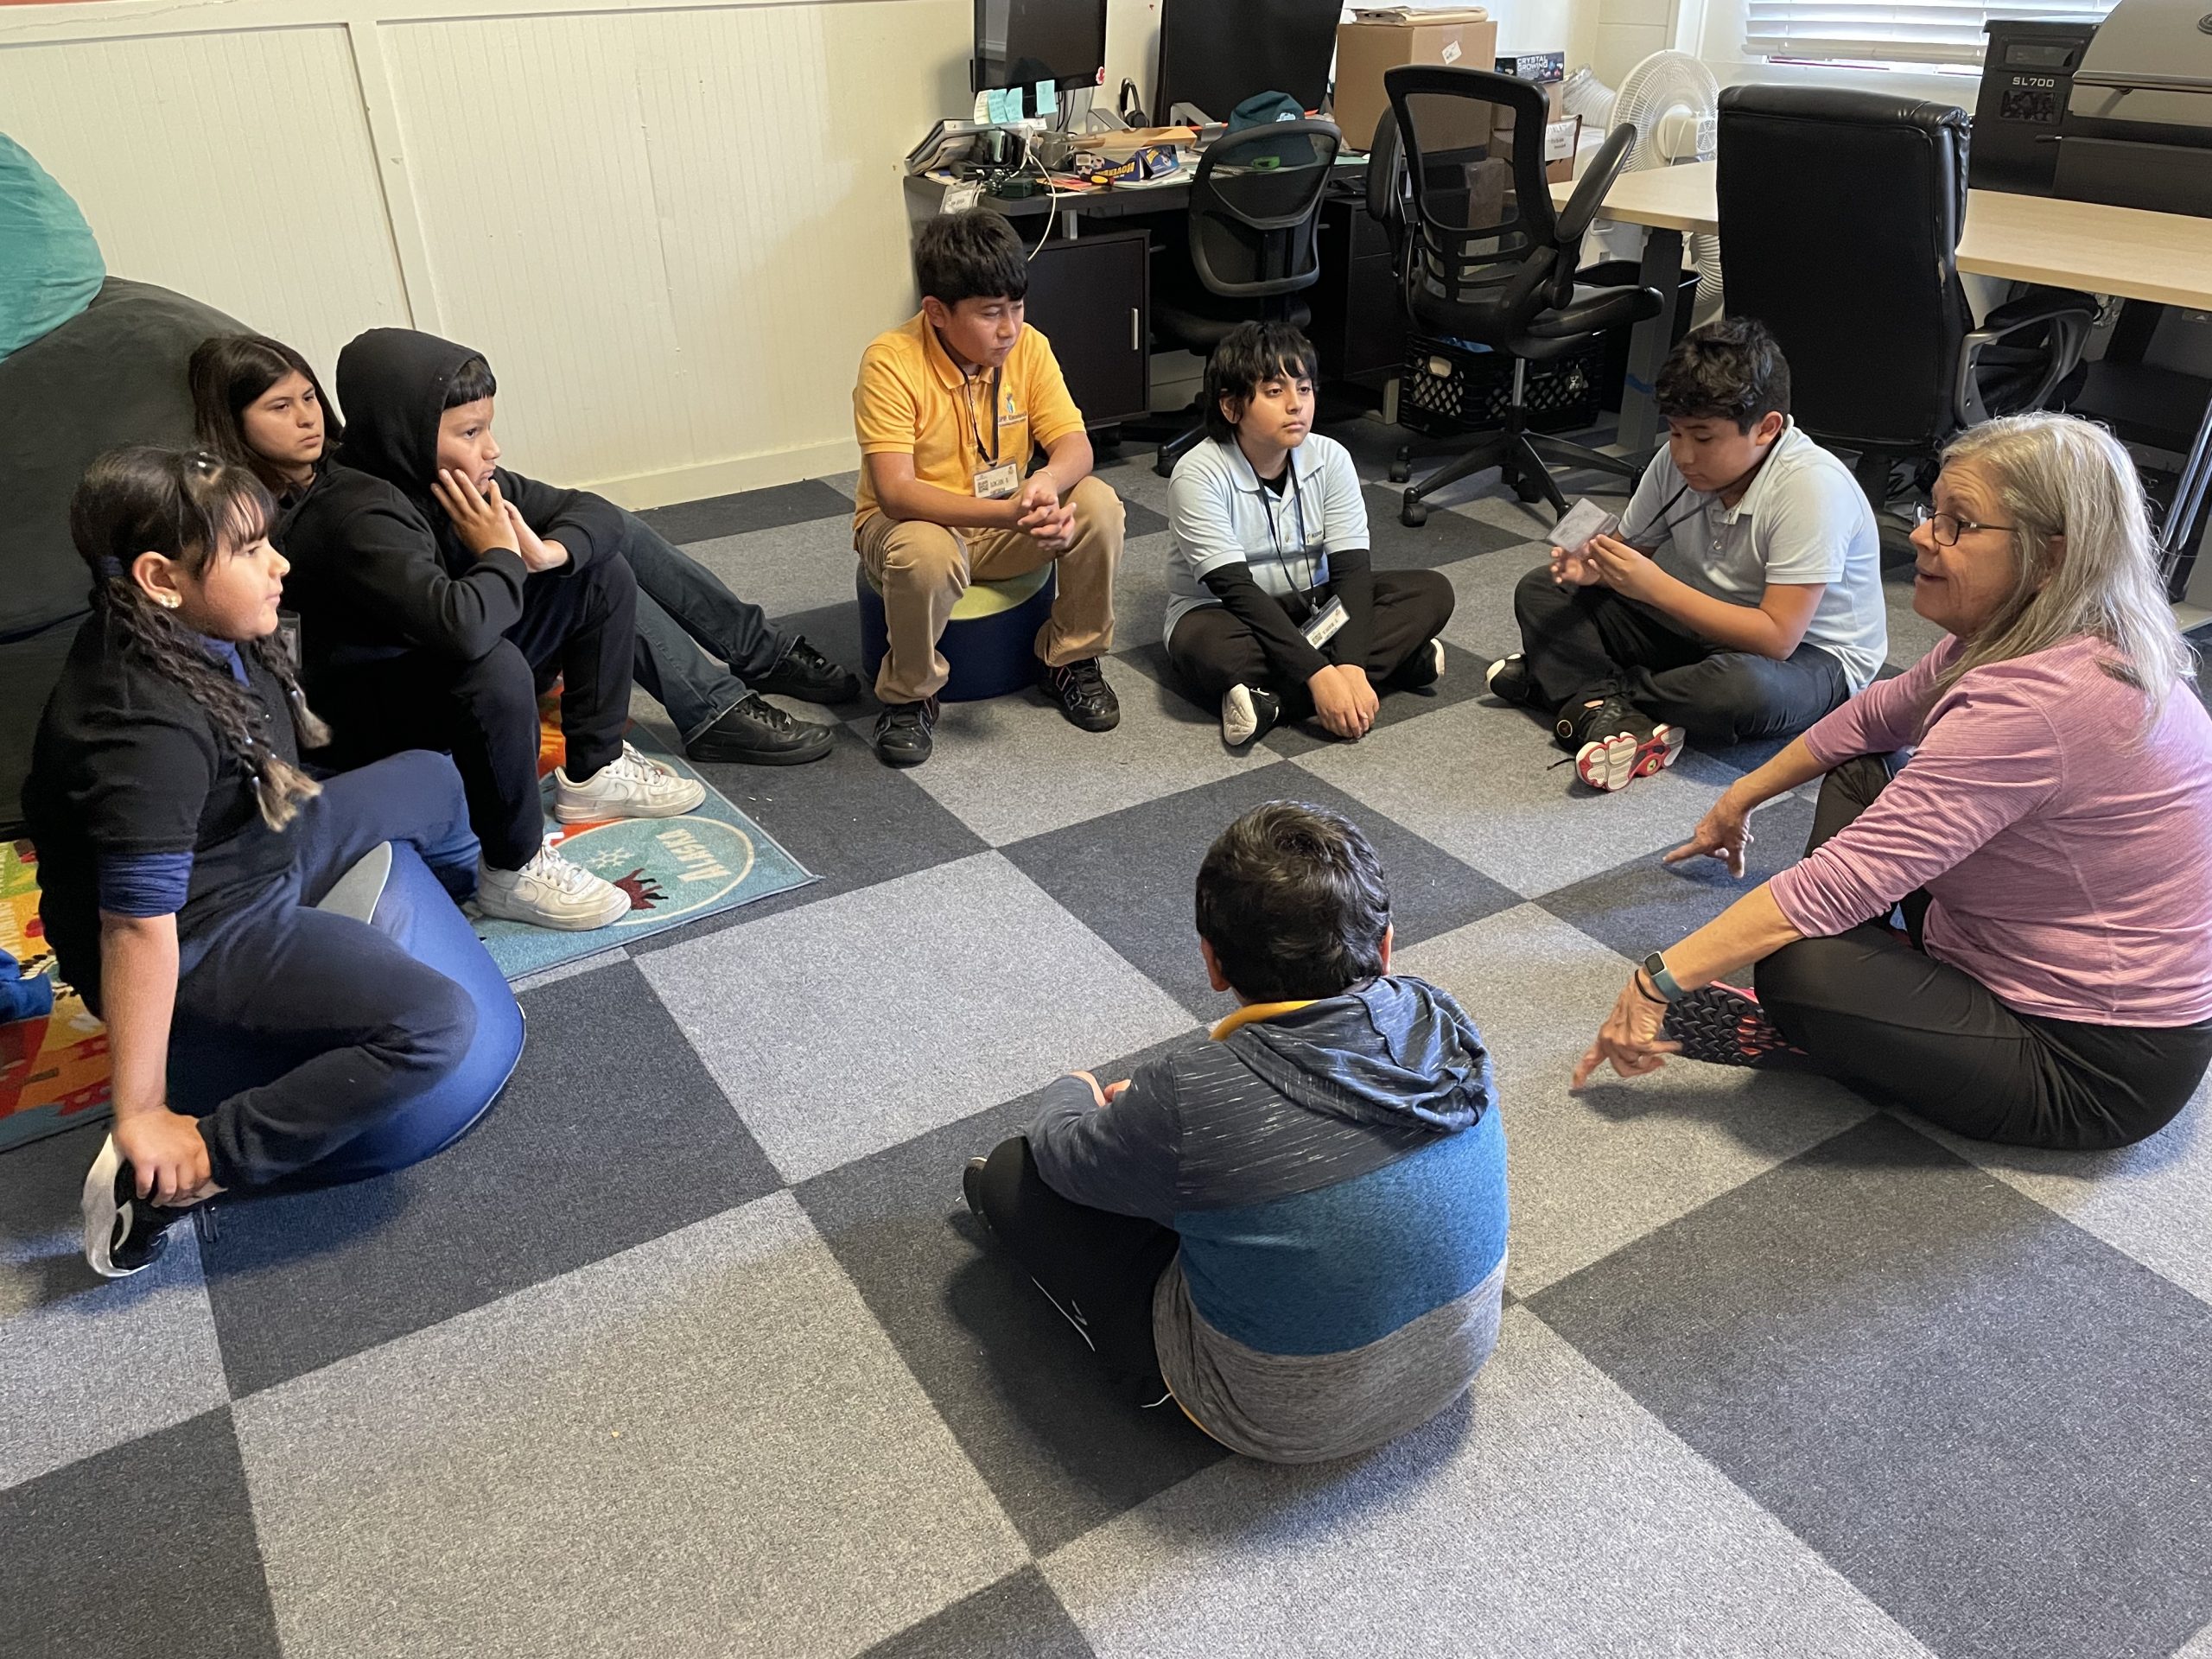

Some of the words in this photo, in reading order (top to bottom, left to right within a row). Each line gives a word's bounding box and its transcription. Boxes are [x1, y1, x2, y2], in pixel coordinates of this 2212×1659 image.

[1517, 55, 1548, 65] CRYSTAL
[1517, 61, 1548, 71] GROWING
[2012, 77, 2055, 87] SL700
[655, 828, 732, 882] ALASKA
